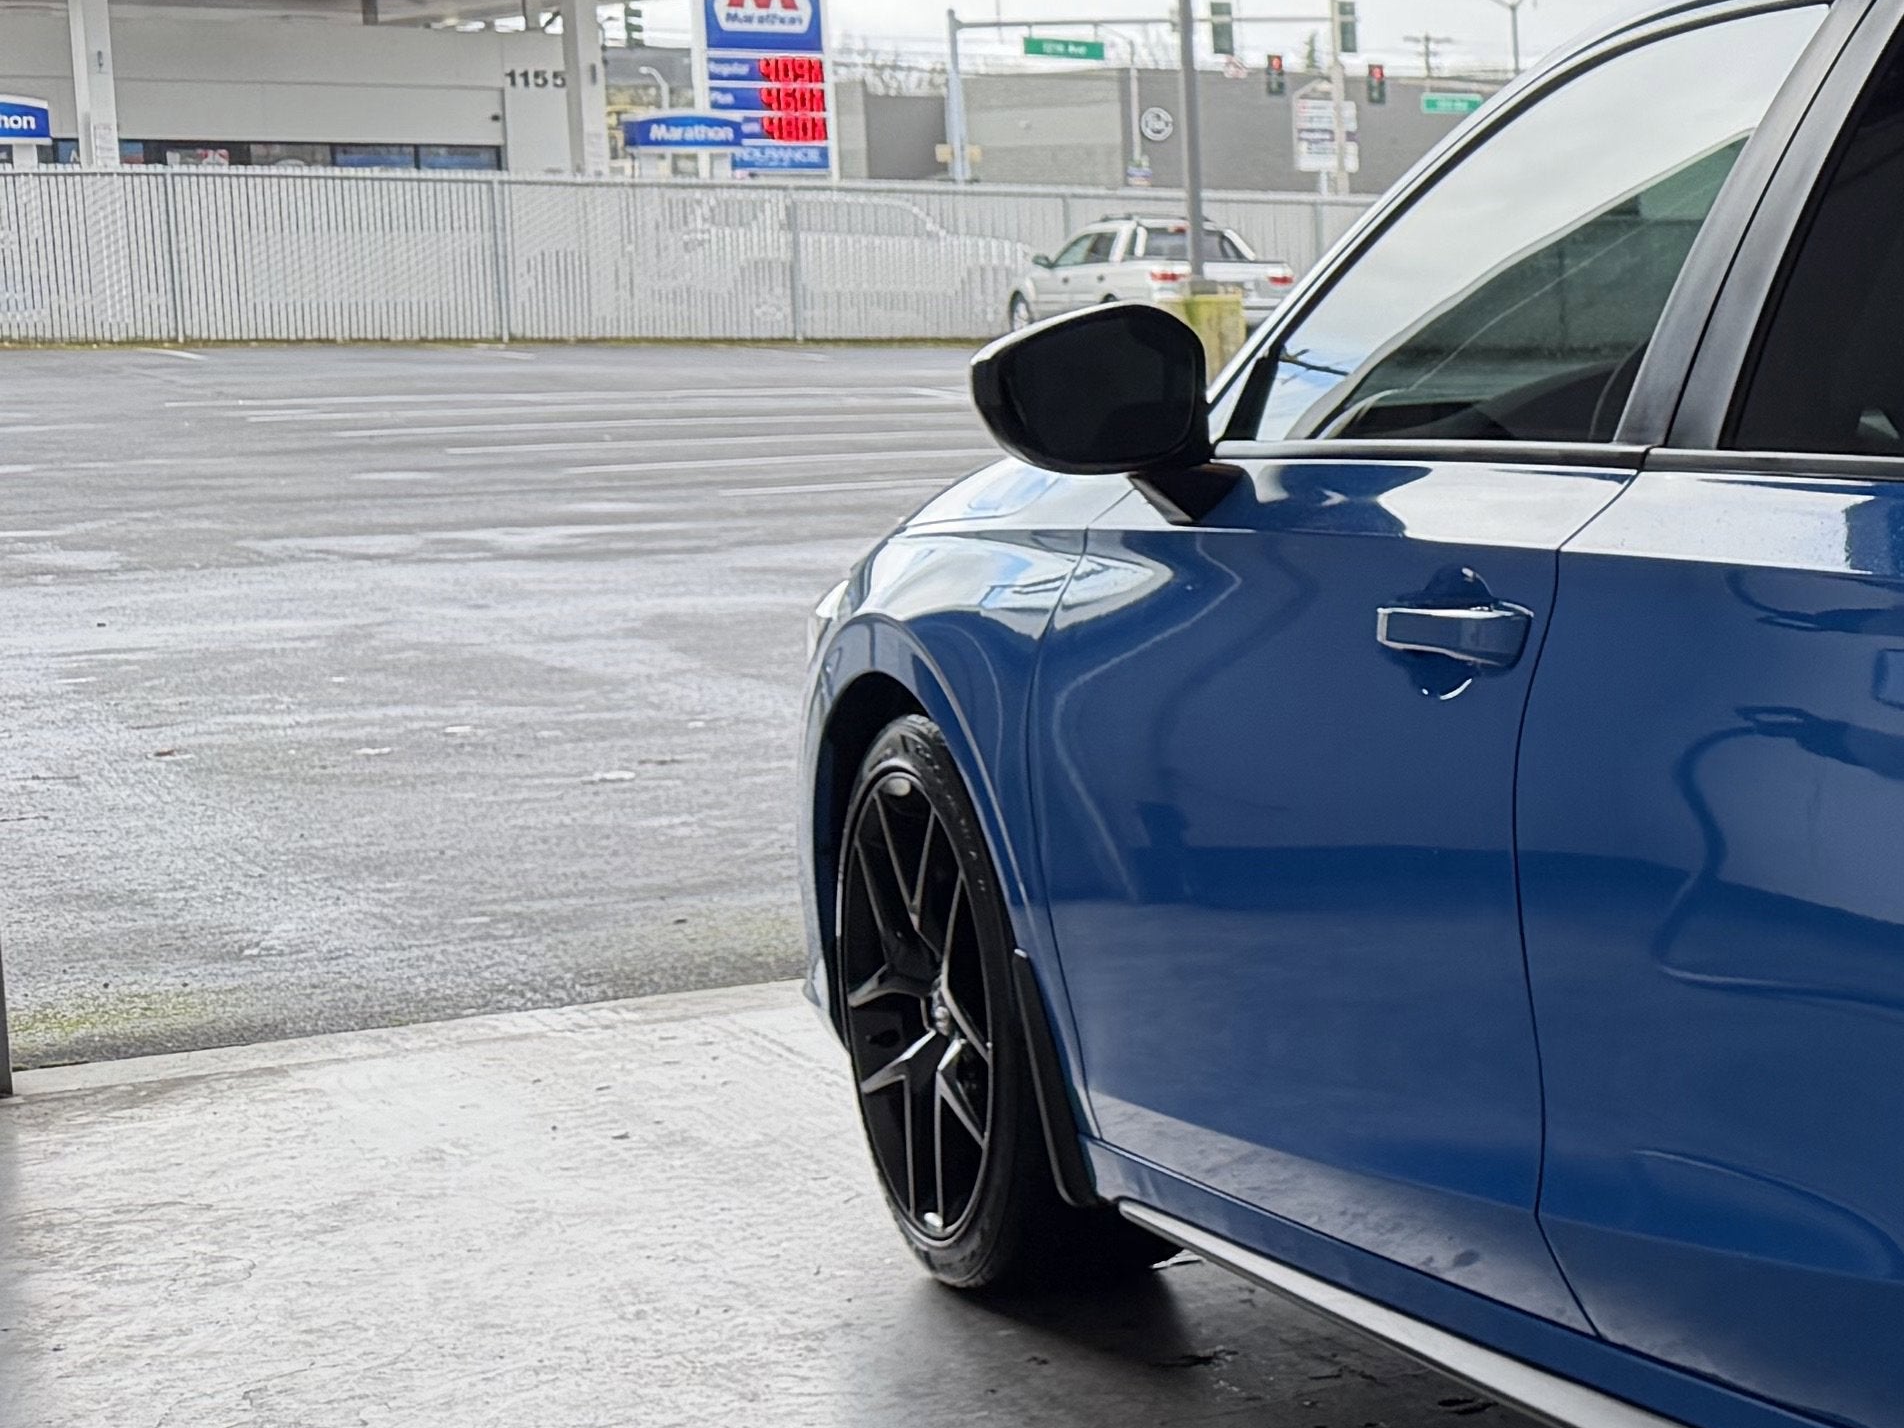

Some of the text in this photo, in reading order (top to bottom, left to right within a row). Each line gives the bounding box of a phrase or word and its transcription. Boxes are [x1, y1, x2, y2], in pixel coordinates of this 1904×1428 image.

[725, 11, 803, 26] Marathon
[504, 69, 566, 88] 1155
[649, 123, 735, 141] Marathon
